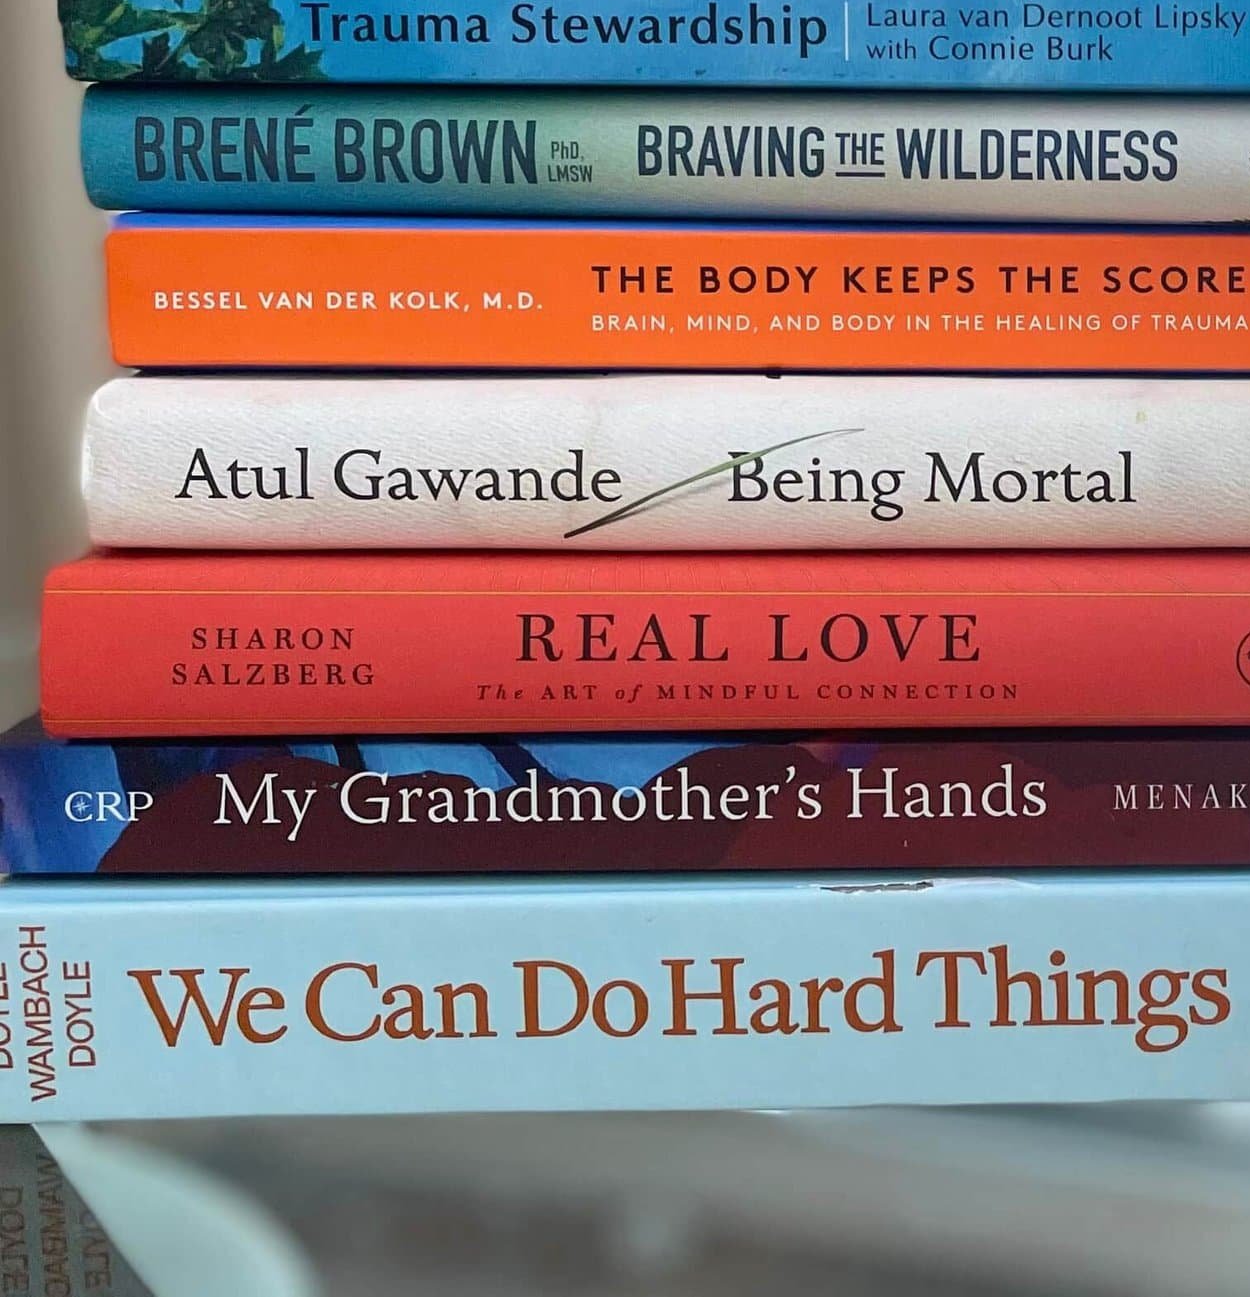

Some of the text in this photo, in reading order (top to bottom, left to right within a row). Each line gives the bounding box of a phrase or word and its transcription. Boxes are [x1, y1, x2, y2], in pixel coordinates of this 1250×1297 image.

[300, 1, 827, 58] Trauma Stewardship
[866, 3, 1246, 37] Laura van Dernoot Lipsky
[866, 36, 1113, 61] with Connie Burk
[134, 105, 538, 184] BRENÉ BROWN
[551, 141, 584, 161] PhD,
[637, 125, 1178, 181] BRAVING THE WILDERNESS
[548, 165, 592, 182] LMSW
[591, 266, 1247, 294] THE BODY KEEPS THE SCORE
[153, 292, 544, 313] BESSEL VAN DER KOLK, M.D.
[591, 314, 1248, 334] BRAIN, MIND, AND BODY IN THE HEALING OF TRAUMA
[175, 447, 622, 502] Atul Gawande
[728, 450, 1137, 521] Being Mortal
[192, 628, 355, 650] SHARON
[515, 614, 980, 662] REAL LOVE
[171, 663, 375, 686] SALZBERG
[477, 684, 1020, 702] The ART of MINDFUL CONNECTION
[64, 791, 154, 822] CRP
[214, 765, 1047, 840] My Grandmother’s Hands
[18, 926, 57, 1102] WAMBACH
[62, 961, 96, 1067] DOYLE
[127, 945, 1231, 1053] We Can Do Hard Things
